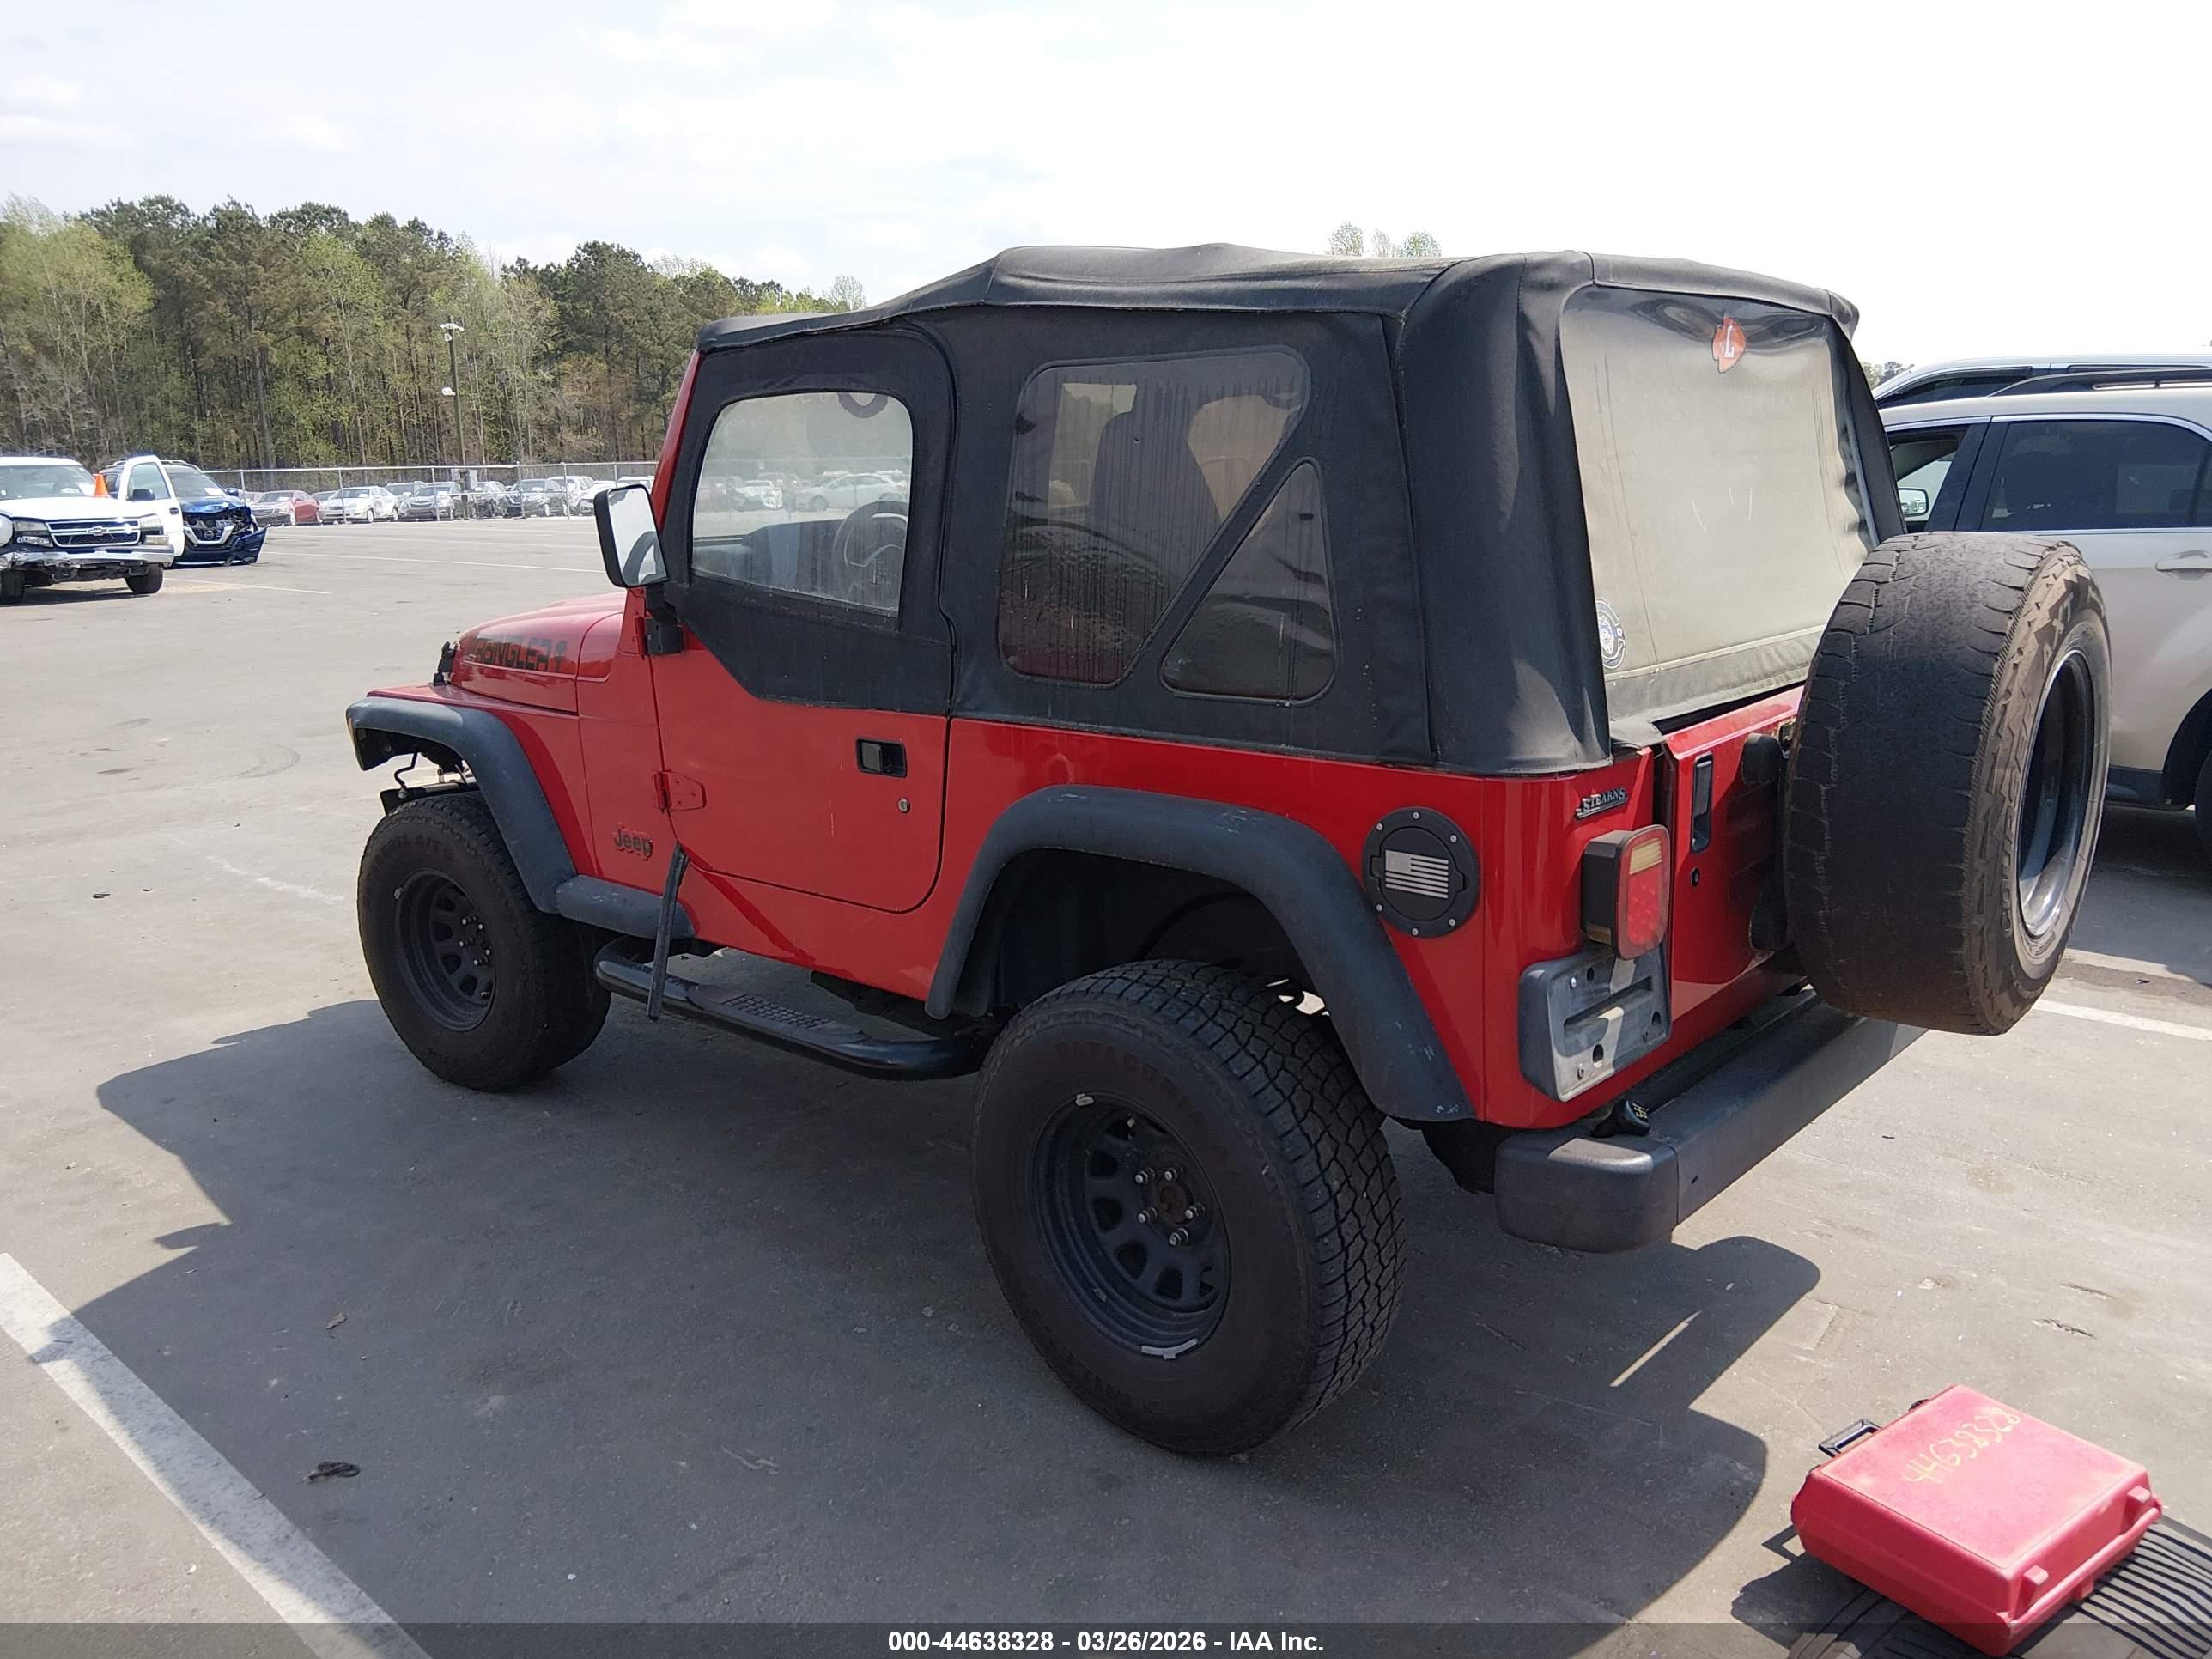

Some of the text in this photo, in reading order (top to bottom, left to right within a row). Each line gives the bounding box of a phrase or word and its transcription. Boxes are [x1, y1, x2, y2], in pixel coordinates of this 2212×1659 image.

[1582, 787, 1626, 811] STEARNS
[613, 827, 653, 860] Jeep
[1901, 1406, 2021, 1485] 44638328
